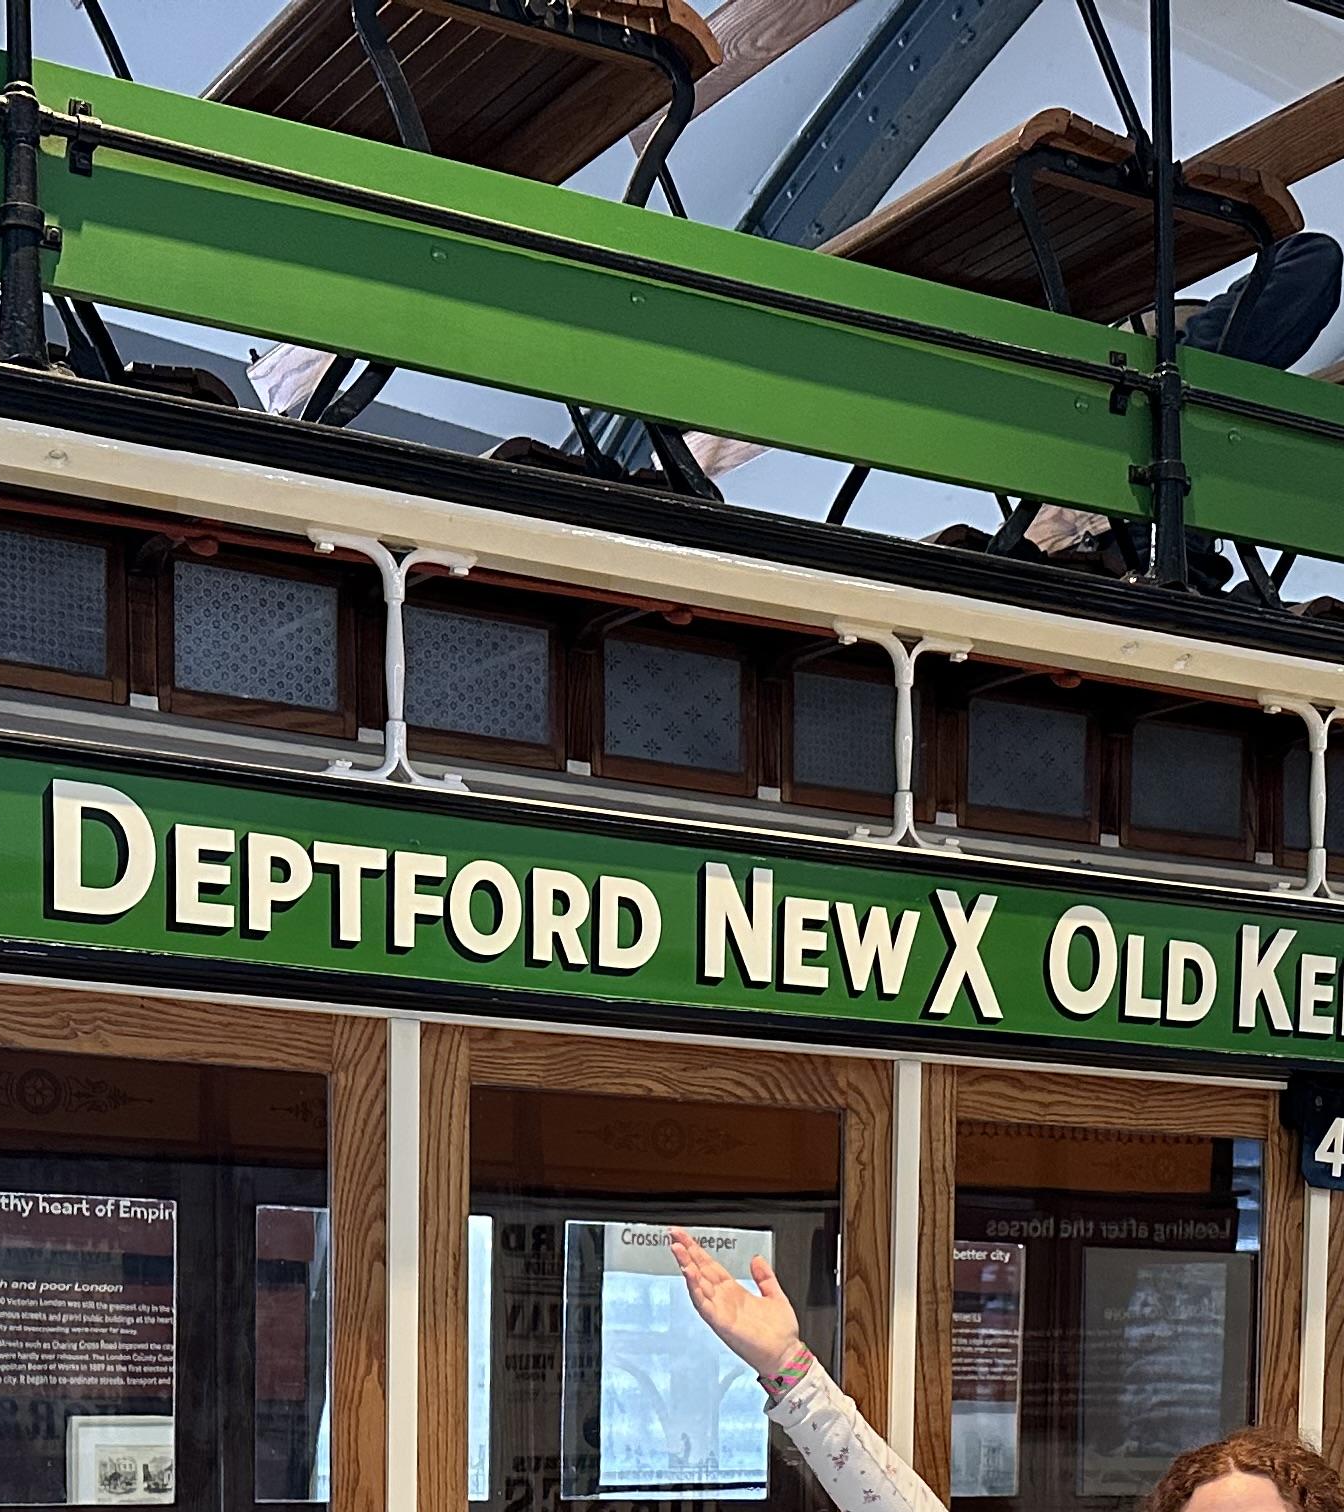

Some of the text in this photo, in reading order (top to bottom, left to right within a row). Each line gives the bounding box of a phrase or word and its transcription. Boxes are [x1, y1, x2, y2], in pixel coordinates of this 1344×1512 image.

[52, 778, 662, 972] DEPTFORD
[704, 861, 922, 996] NEW
[1049, 903, 1218, 1023] OLD
[38, 1196, 90, 1217] heart
[95, 1199, 116, 1218] of
[621, 1228, 671, 1247] Crossin
[953, 1247, 1011, 1263] better city
[11, 1280, 36, 1290] and
[39, 1282, 72, 1294] poor
[74, 1282, 124, 1293] London
